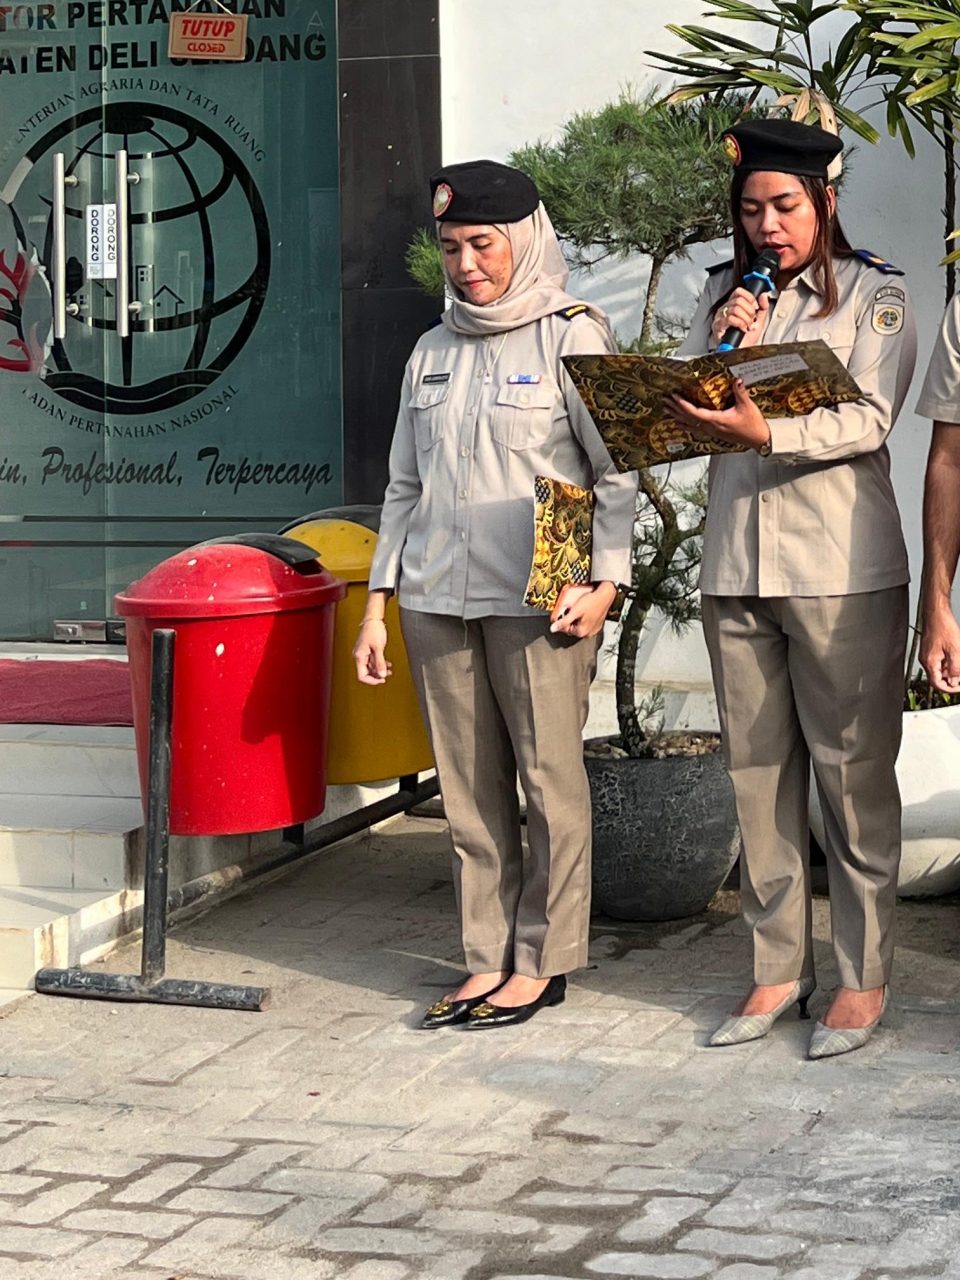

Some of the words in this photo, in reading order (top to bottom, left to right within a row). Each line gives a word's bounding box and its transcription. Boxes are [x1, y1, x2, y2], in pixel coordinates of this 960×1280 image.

[182, 19, 235, 37] TUTUP
[187, 42, 226, 53] CLOSED
[88, 41, 157, 71] DELI
[80, 78, 143, 98] AGRARIA
[149, 79, 181, 96] DAN
[186, 88, 219, 115] TATA
[224, 114, 265, 162] RUANG
[91, 209, 99, 261] DORONG
[107, 208, 115, 260] DORONG
[22, 387, 67, 421] ADAN
[69, 414, 166, 438] PERTANAHAN
[170, 384, 240, 431] NASIONAL
[41, 446, 182, 496] Profesional,
[197, 446, 333, 495] Terpercaya
